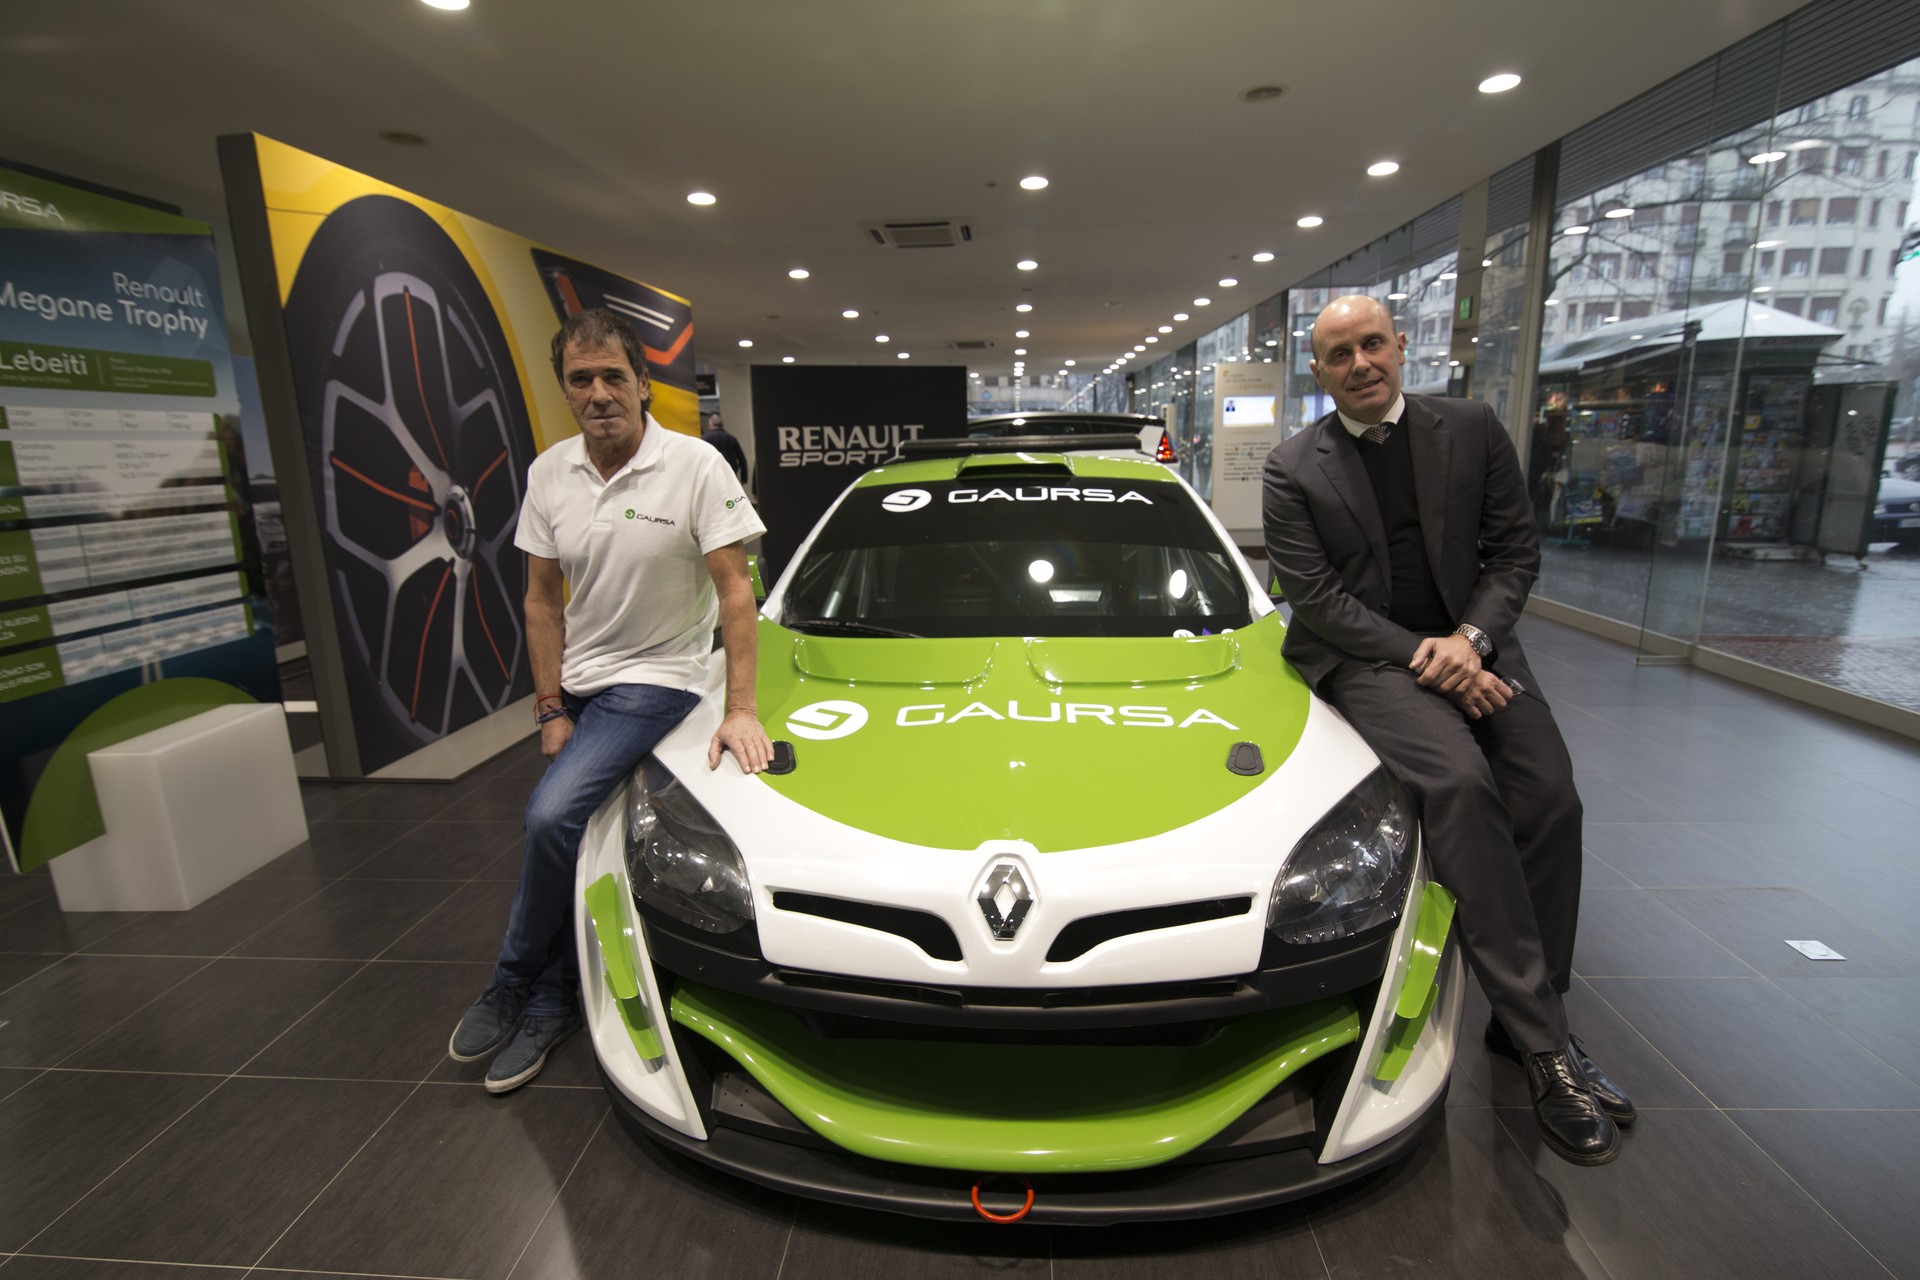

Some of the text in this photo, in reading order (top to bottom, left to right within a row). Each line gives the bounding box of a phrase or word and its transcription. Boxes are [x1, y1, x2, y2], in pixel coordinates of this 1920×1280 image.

[112, 271, 206, 308] Renault
[117, 299, 209, 340] Trophy
[0, 349, 88, 375] Lebeiti
[777, 424, 924, 451] RENAULT
[779, 450, 888, 467] SPORT
[947, 486, 1153, 505] GAURSA
[636, 513, 676, 526] GAURSA
[895, 700, 1240, 731] GAURSA
